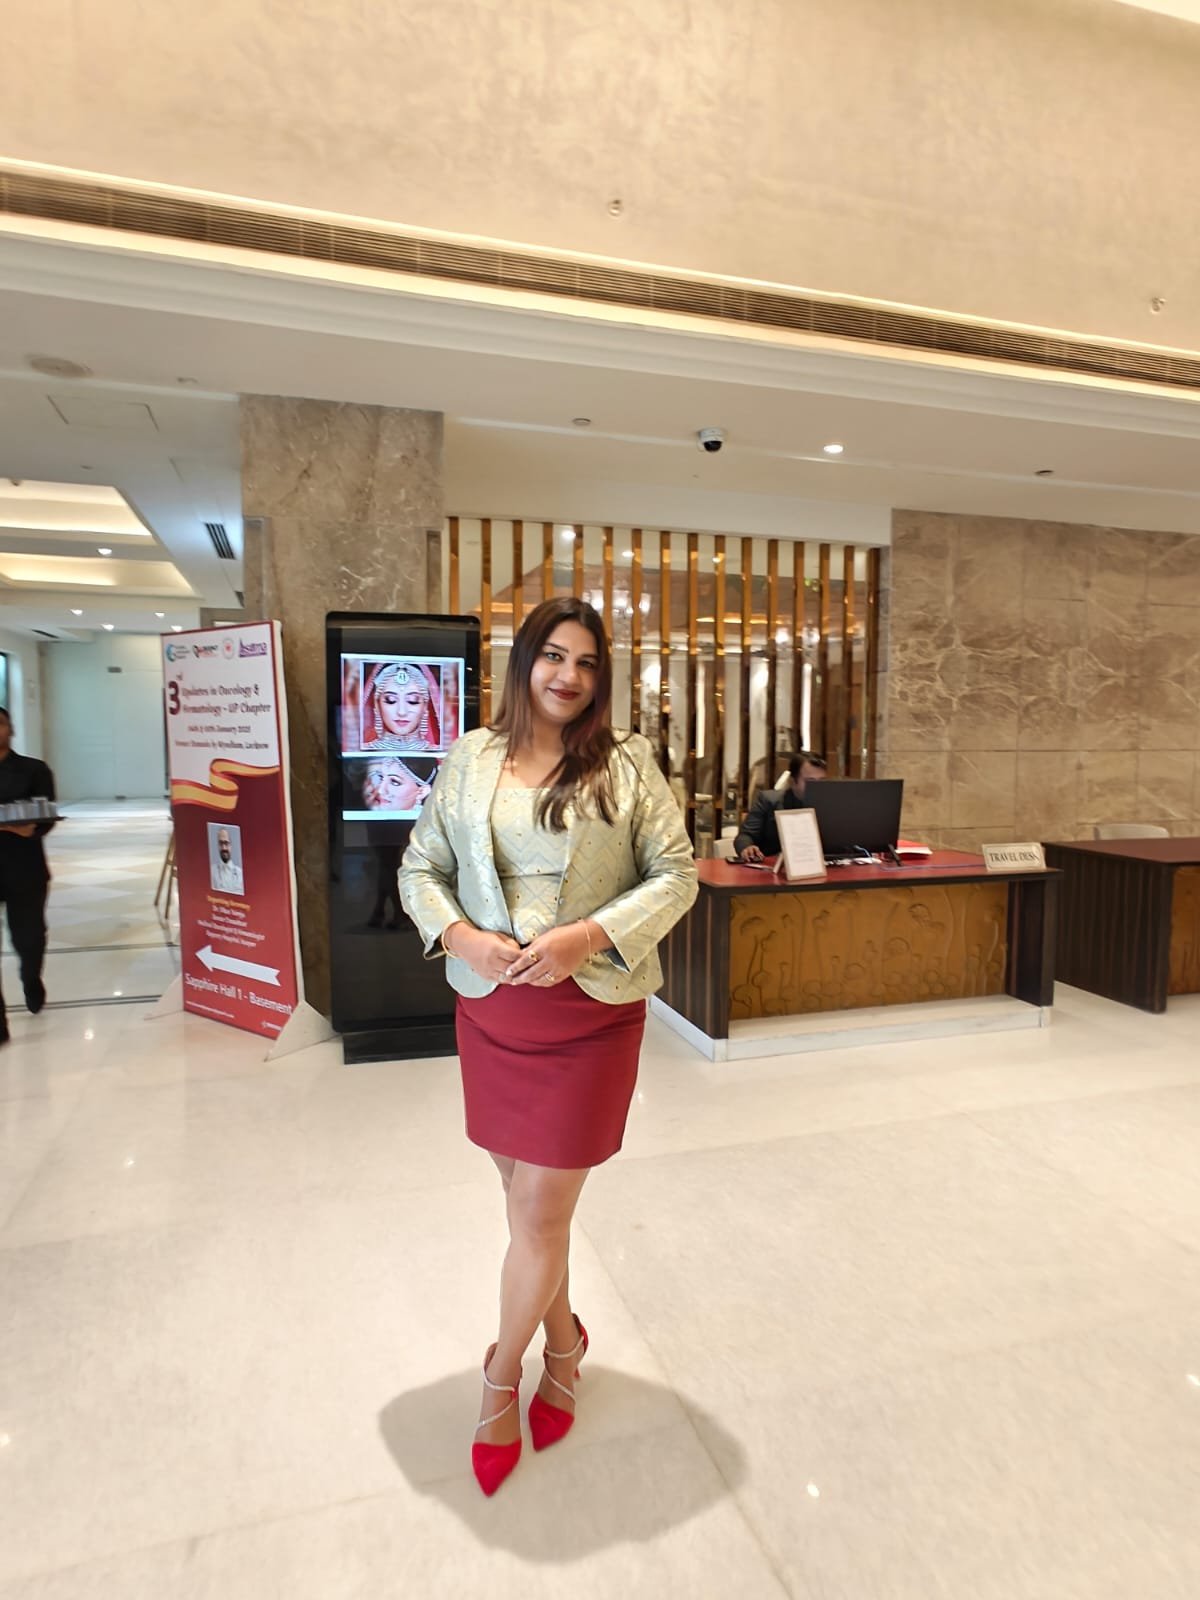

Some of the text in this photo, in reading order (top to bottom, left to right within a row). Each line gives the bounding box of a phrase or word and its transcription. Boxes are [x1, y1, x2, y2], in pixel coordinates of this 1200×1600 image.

[168, 681, 180, 715] 3
[219, 684, 252, 698] Oncology
[240, 702, 271, 716] Chapter
[990, 852, 1018, 862] TRAVEL
[185, 973, 219, 993] Sapphire
[219, 983, 237, 999] Hall
[237, 988, 243, 1000] 1
[248, 991, 292, 1016] Basement
